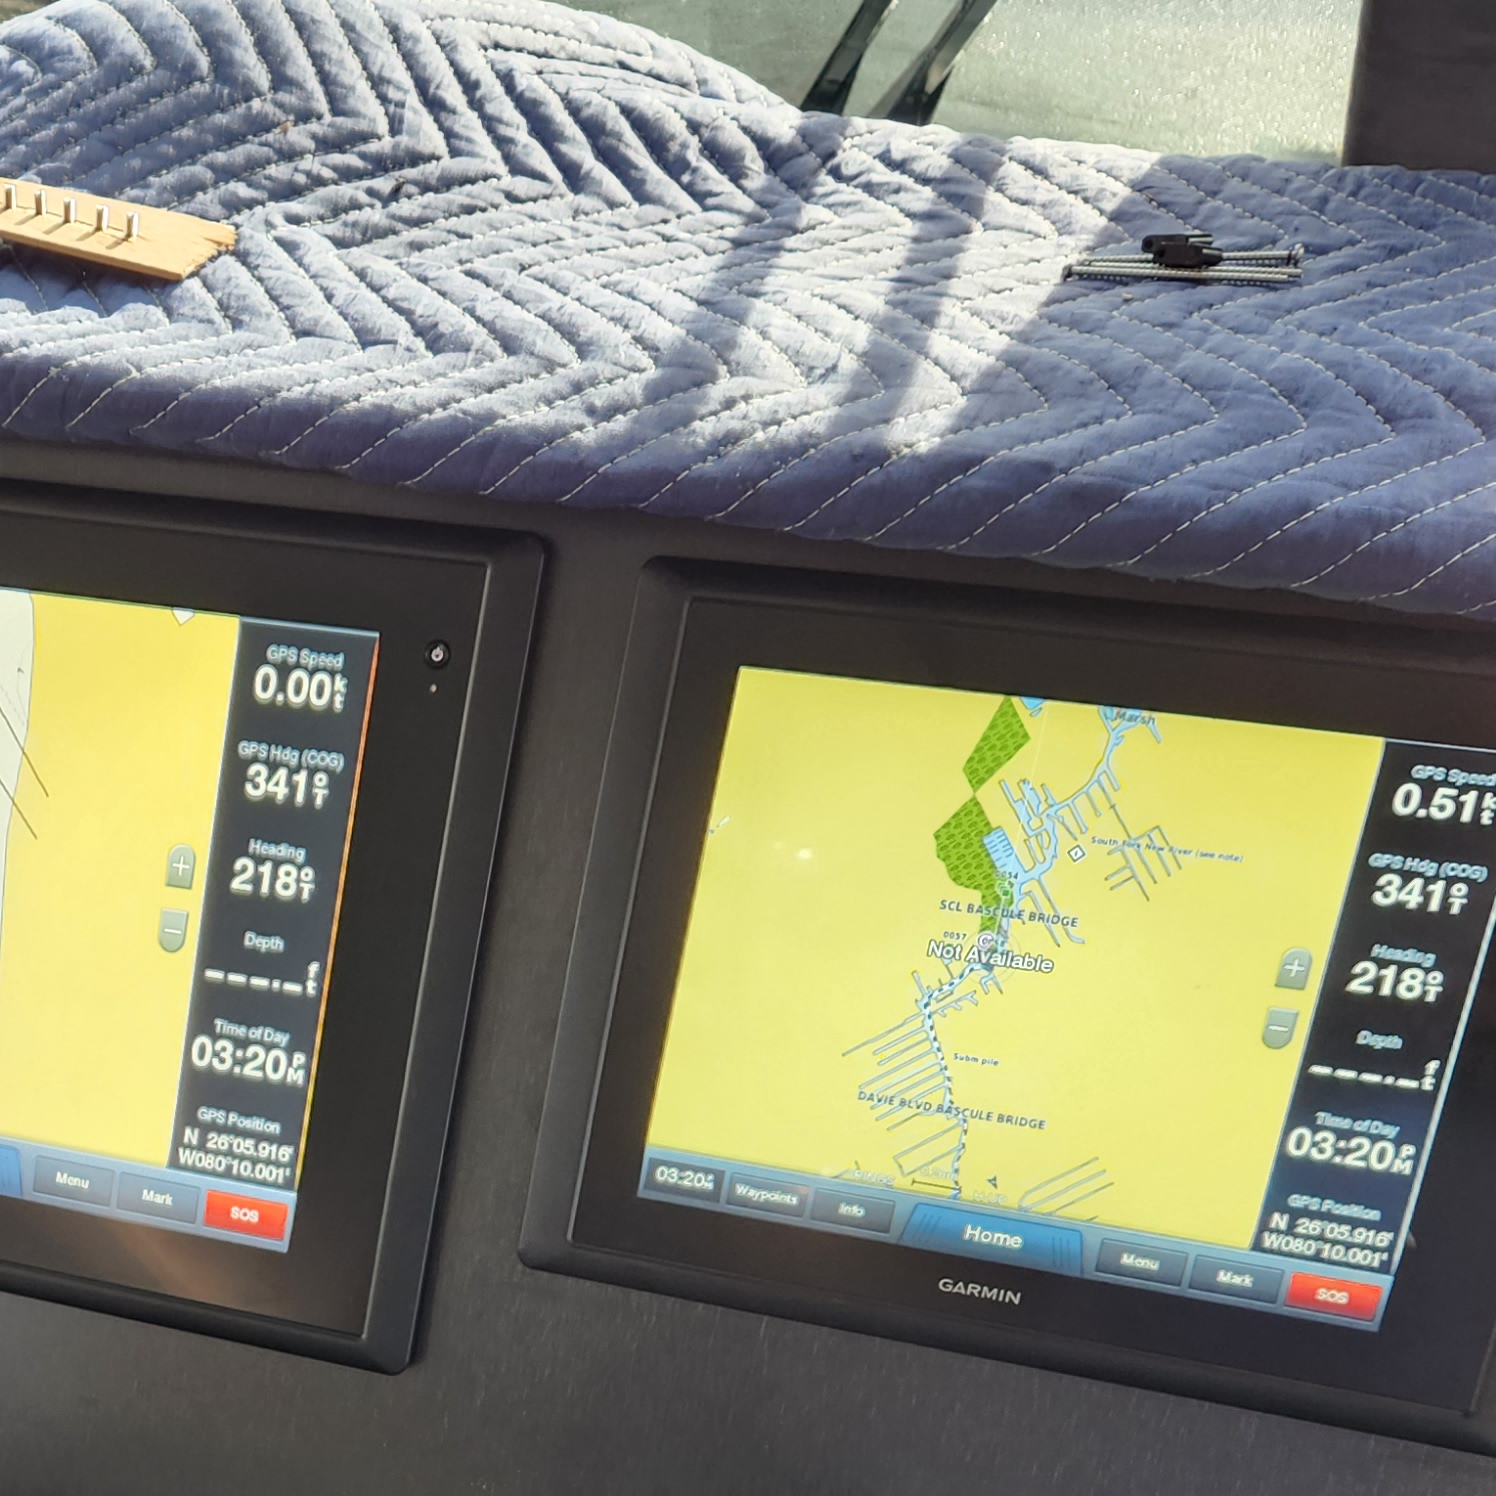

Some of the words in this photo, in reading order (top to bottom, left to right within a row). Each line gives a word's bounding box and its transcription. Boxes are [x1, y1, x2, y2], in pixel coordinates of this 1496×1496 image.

[267, 644, 298, 665] GPS
[300, 648, 345, 671] Speed
[1115, 710, 1156, 725] Marsh
[238, 740, 269, 759] GPS
[269, 744, 300, 766] Hdg
[301, 749, 345, 772] (COG)
[1411, 765, 1447, 781] GPS
[248, 839, 306, 863] Heading
[1092, 835, 1119, 847] South
[1368, 853, 1404, 870] GPS
[1440, 862, 1488, 882] (COG)
[939, 899, 963, 912] SCL
[967, 903, 1025, 920] BASCULE
[1028, 911, 1079, 928] BRIDGE
[244, 932, 285, 954] Depth
[927, 939, 963, 961] Not
[965, 945, 1054, 974] Available
[1371, 944, 1436, 968] Heading
[214, 1018, 246, 1038] Time
[248, 1025, 264, 1040] of
[264, 1026, 291, 1048] Day
[1356, 1030, 1403, 1050] Depth
[192, 1035, 286, 1082] 03:20
[954, 1052, 979, 1063] Subm
[981, 1056, 1000, 1067] pile
[197, 1106, 226, 1125] GPS
[227, 1111, 281, 1134] Position
[857, 1091, 895, 1107] DAVIE
[899, 1097, 933, 1112] BLVD
[936, 1103, 994, 1122] BASCULE
[997, 1113, 1047, 1130] BRIDGE
[183, 1127, 199, 1146] N
[1315, 1111, 1352, 1129] Time
[1353, 1117, 1369, 1132] of
[1369, 1120, 1401, 1139] Day
[1287, 1127, 1395, 1170] 03:20
[55, 1171, 89, 1190] Menu
[141, 1188, 174, 1207] Mark
[735, 1182, 800, 1207] Waypoints
[230, 1206, 259, 1224] SOS
[838, 1202, 864, 1218] Info
[1288, 1194, 1321, 1210] GPS
[1321, 1199, 1382, 1222] Position
[1271, 1212, 1289, 1230] N
[963, 1224, 1023, 1250] Home
[1120, 1253, 1160, 1271] Menu
[1216, 1270, 1254, 1287] Mark
[938, 1278, 1021, 1305] GARMIN
[1315, 1287, 1349, 1305] SOS
